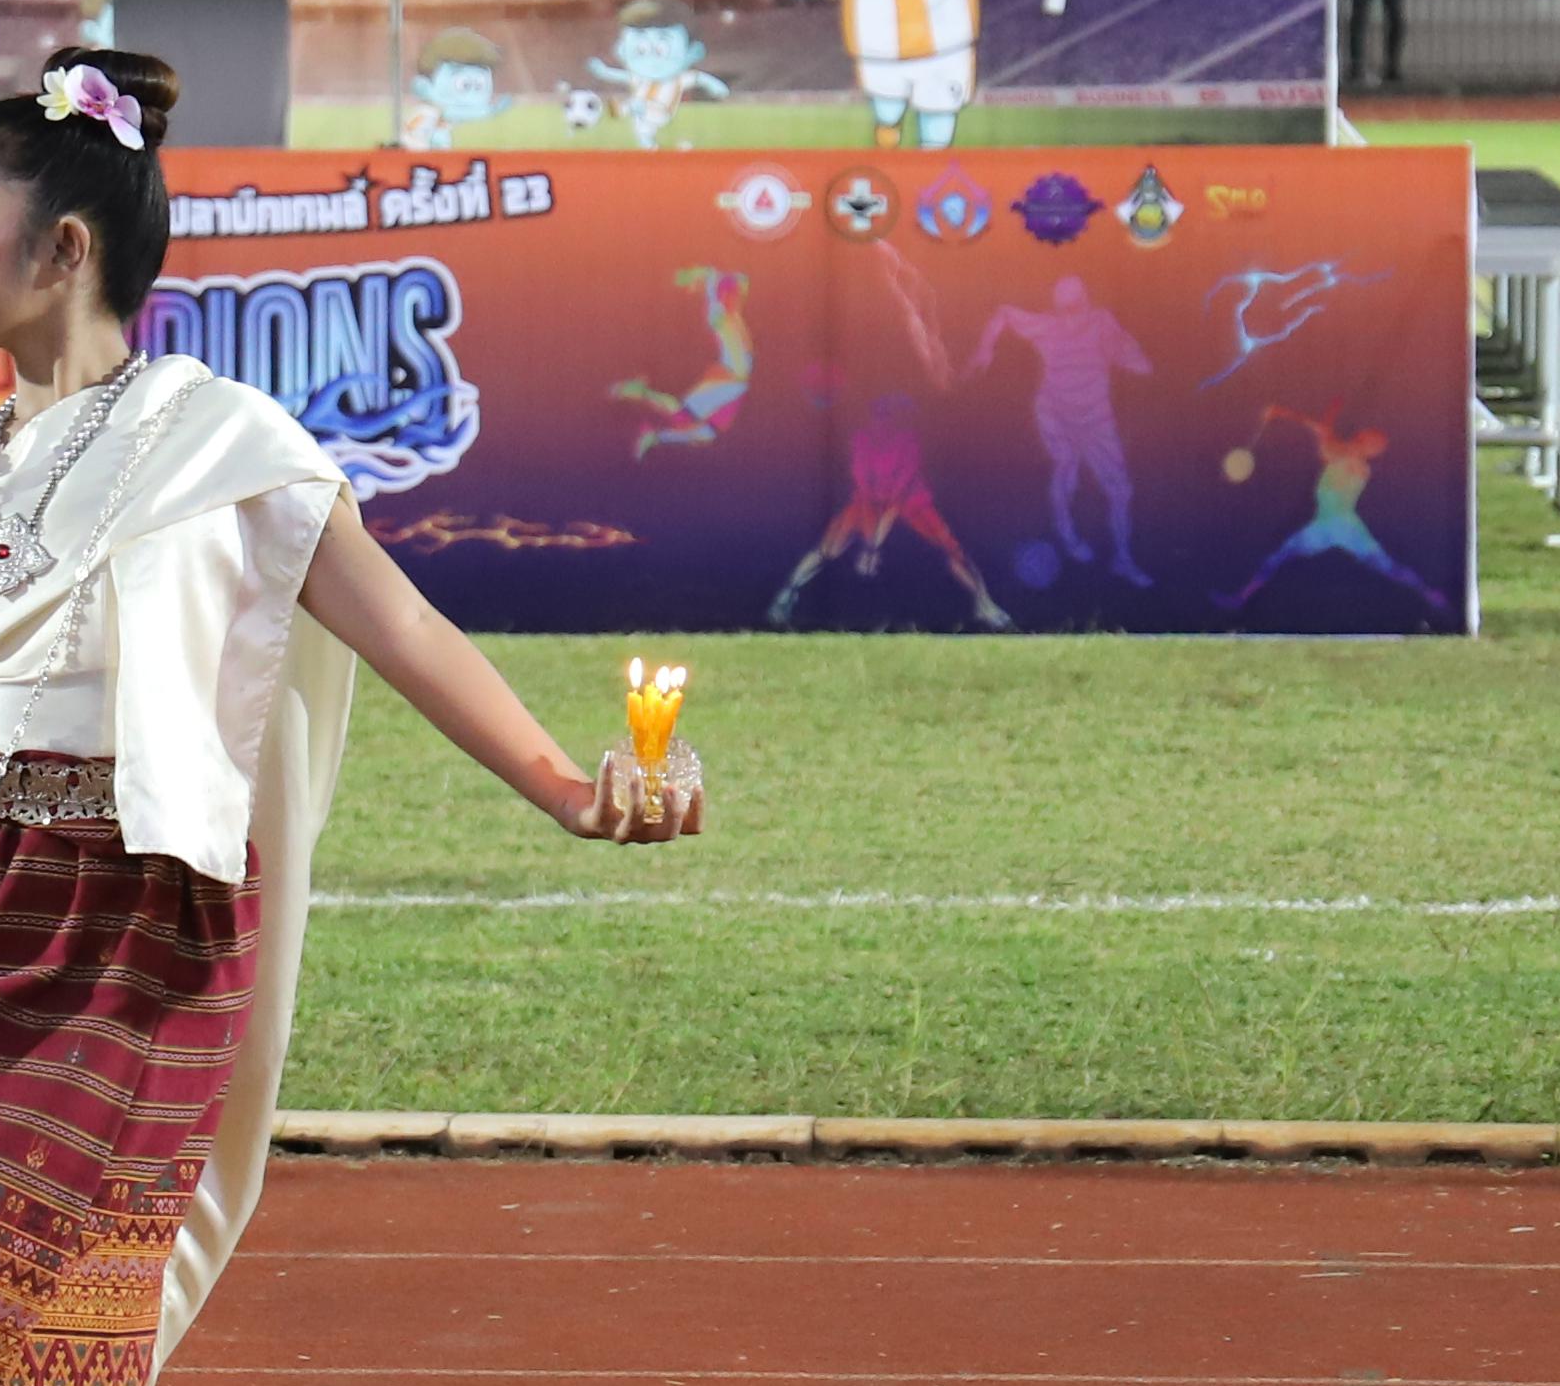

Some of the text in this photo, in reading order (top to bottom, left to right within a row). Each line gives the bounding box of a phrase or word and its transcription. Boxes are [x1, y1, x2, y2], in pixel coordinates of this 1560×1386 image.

[380, 159, 491, 227] ครั้งที่
[500, 174, 553, 217] 23
